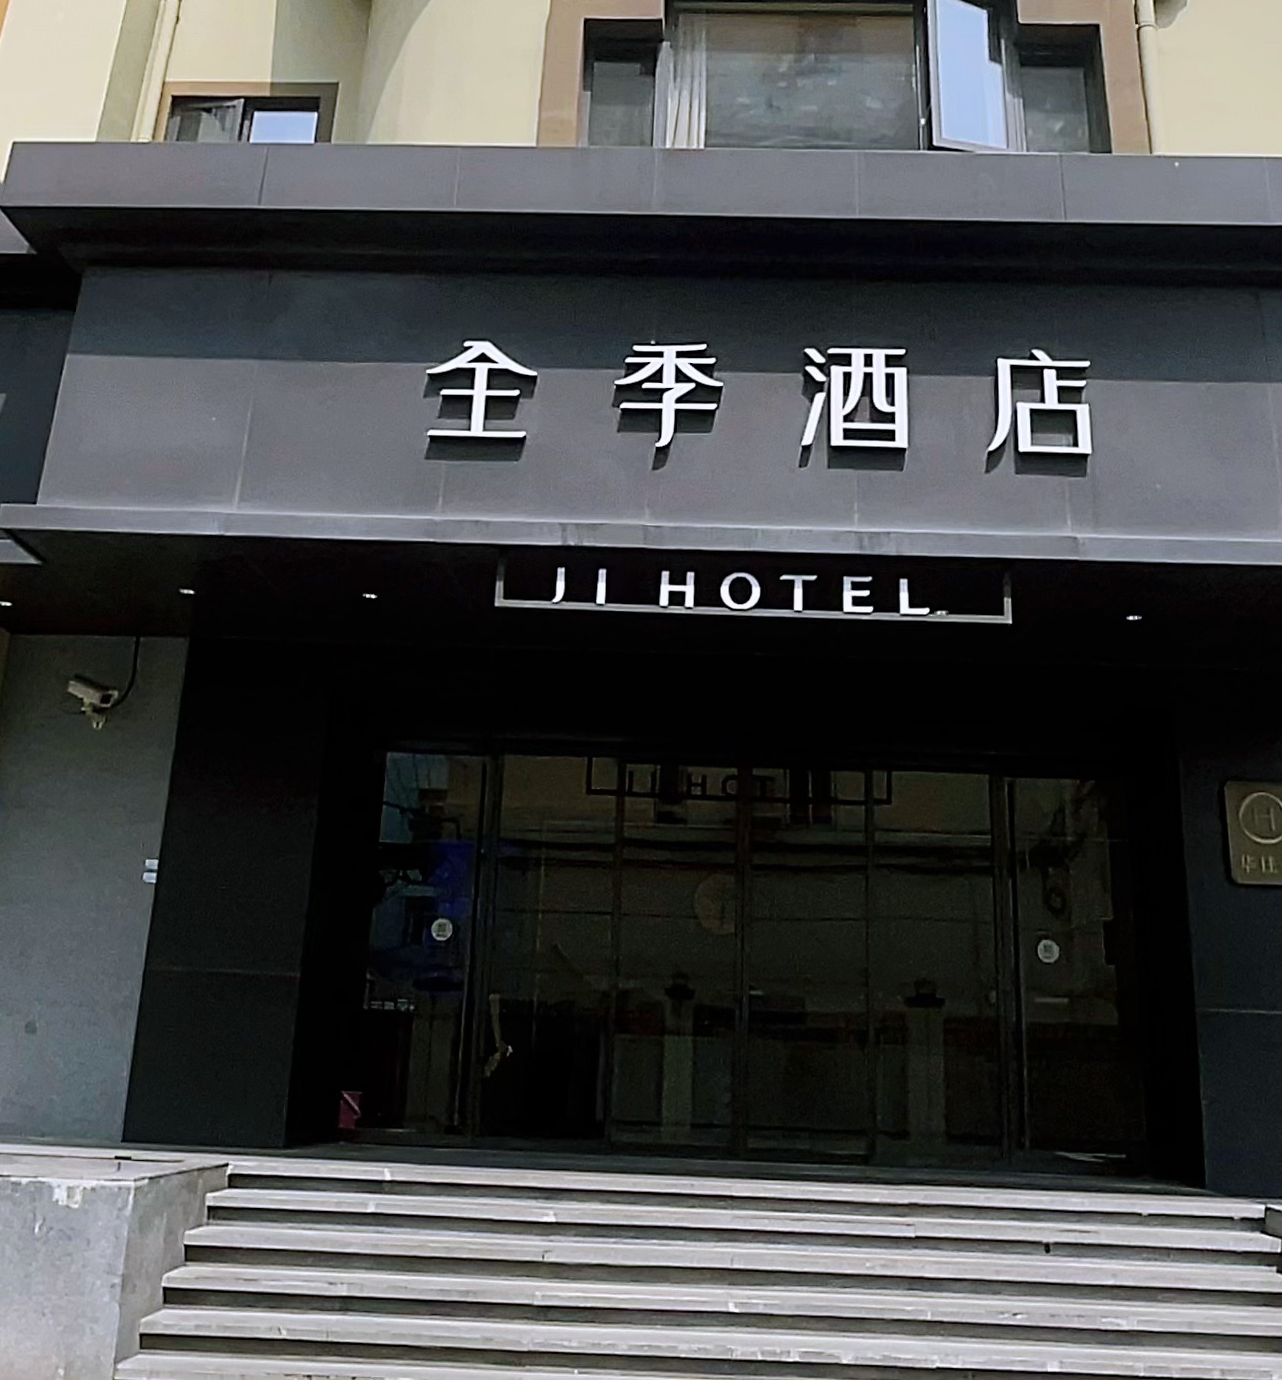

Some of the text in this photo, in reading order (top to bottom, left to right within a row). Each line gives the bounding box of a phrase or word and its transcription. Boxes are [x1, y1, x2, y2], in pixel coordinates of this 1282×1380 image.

[424, 339, 1093, 455] 全季酒店
[551, 566, 930, 616] JI HOTEL
